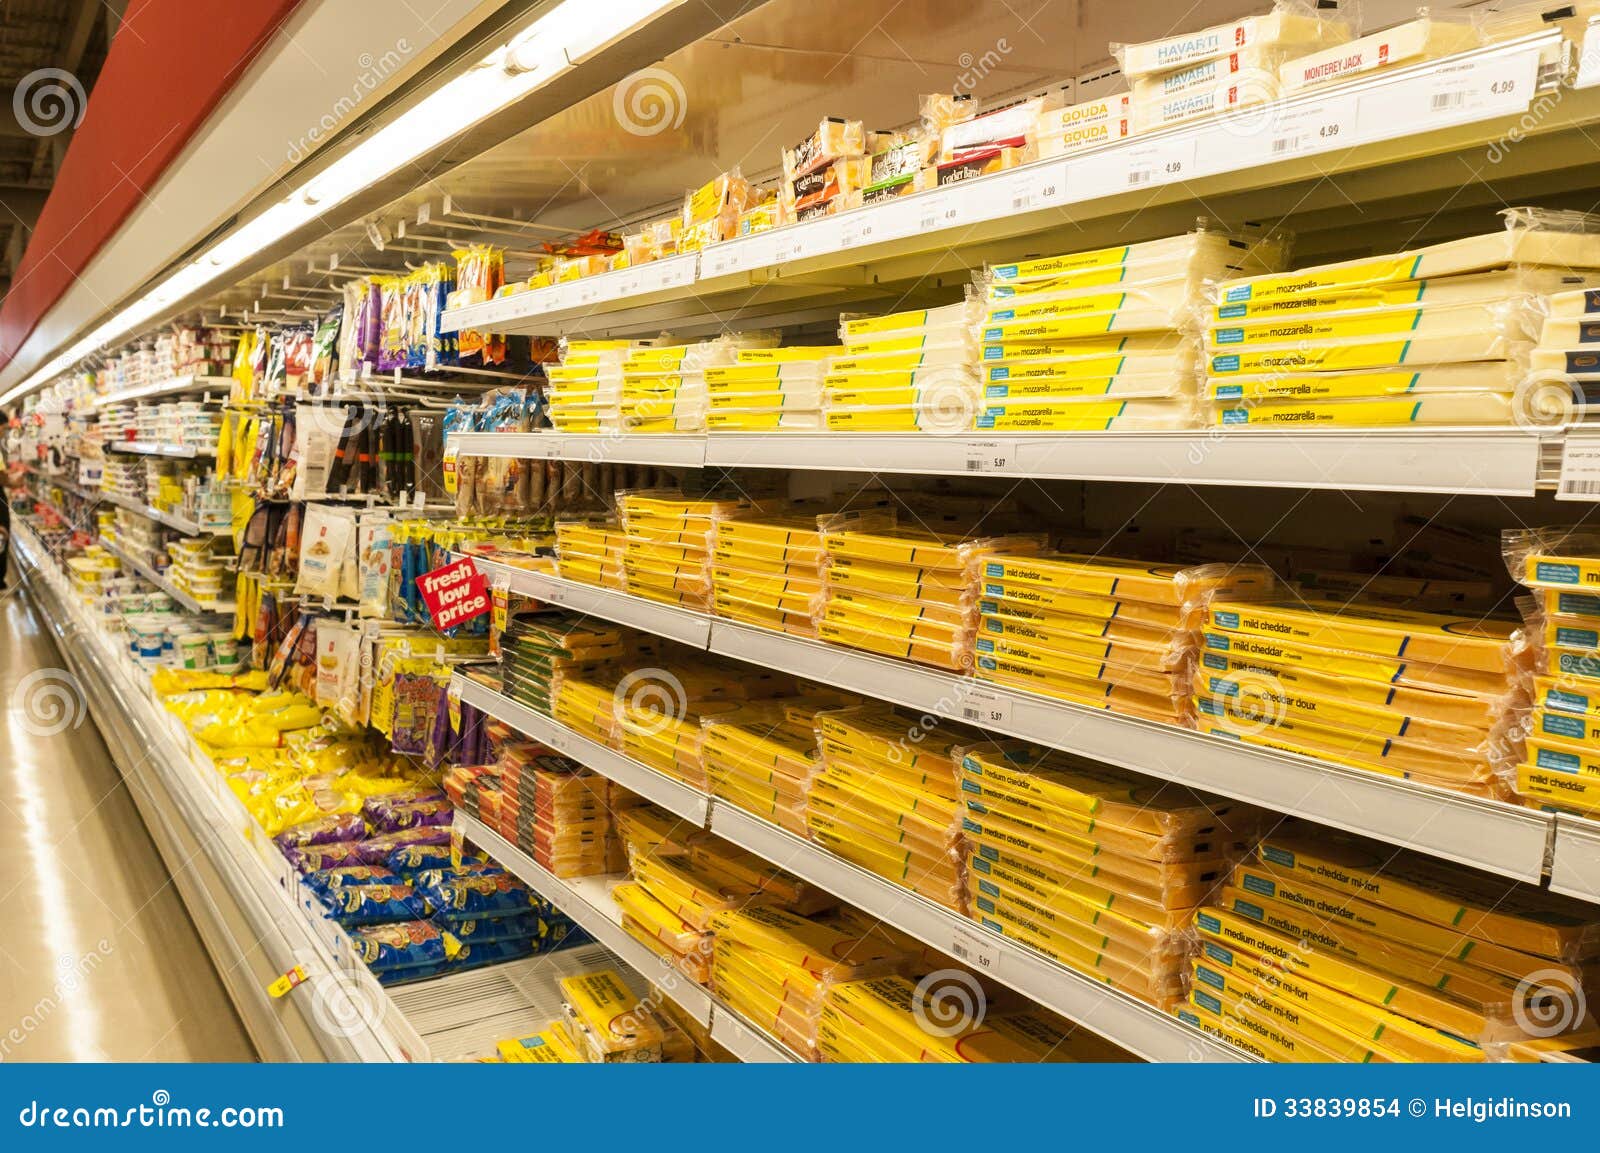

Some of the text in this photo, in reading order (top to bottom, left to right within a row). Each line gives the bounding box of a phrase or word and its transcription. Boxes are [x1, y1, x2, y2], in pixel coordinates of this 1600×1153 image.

[1158, 34, 1219, 59] HAVARTI
[1164, 62, 1216, 89] HAVARTI
[1304, 60, 1342, 81] MONTEREY
[1342, 54, 1362, 72] JACK
[1490, 80, 1514, 95] 4.99
[1163, 94, 1215, 116] HAVARTI
[1062, 104, 1108, 123] GOUDA
[1063, 125, 1108, 143] GOUDA
[1319, 124, 1339, 138] 4.99
[1165, 161, 1181, 174] 4.99
[1043, 185, 1055, 197] 4.99
[1033, 260, 1063, 272] mozzarella
[1276, 280, 1317, 295] mozzarella
[1273, 298, 1317, 311] mozzarella
[1019, 326, 1047, 337] mozzarella
[1270, 324, 1313, 337] mozzarella
[1020, 346, 1052, 356] mozzarella
[1264, 355, 1306, 367] mozzarella
[1026, 368, 1055, 377] mozzarella
[1023, 384, 1050, 393] mozzarella
[1022, 408, 1053, 417] mozzarella
[1273, 411, 1316, 422] mozzarella
[995, 458, 1006, 468] 5.97
[424, 563, 472, 594] fresh
[1006, 569, 1018, 579] mild
[1019, 570, 1041, 580] cheddar
[438, 583, 470, 606] low
[1006, 589, 1018, 599] mild
[1019, 591, 1041, 602] cheddar
[438, 596, 486, 627] price
[1005, 624, 1037, 639] mild cheddar
[1243, 619, 1259, 630] mild
[1260, 622, 1292, 634] cheddar
[1233, 641, 1250, 651] mild
[1251, 644, 1283, 657] cheddar
[999, 662, 1010, 672] mild
[1231, 661, 1247, 671] mild
[1249, 663, 1281, 678] cheddar
[1262, 692, 1294, 706] cheddar
[1296, 698, 1316, 711] doux
[991, 712, 1002, 721] 5.97
[1228, 707, 1243, 718] mild
[985, 769, 1006, 783] medium
[1007, 775, 1030, 790] cheddar
[1529, 774, 1548, 786] mild
[1550, 777, 1586, 793] cheddar
[984, 828, 1006, 842] medium
[1007, 835, 1029, 850] cheddar
[1001, 857, 1046, 879] medium cheddar
[993, 868, 1035, 892] medium cheddar
[1317, 865, 1349, 883] cheddar
[1351, 876, 1380, 894] mi-fort
[1015, 895, 1036, 912] cheddar
[1279, 889, 1316, 908] medium
[1317, 901, 1356, 919] cheddar
[1224, 927, 1256, 946] medium
[1267, 914, 1300, 935] medium
[1302, 928, 1338, 949] cheddar
[978, 955, 990, 968] 5.97
[1252, 965, 1281, 987] cheddar
[1282, 982, 1308, 1001] mi-fort
[1244, 991, 1272, 1012] cheddar
[1273, 1006, 1299, 1025] mi-fort
[1240, 1016, 1269, 1036] cheddar
[1270, 1029, 1294, 1052] mi-fort
